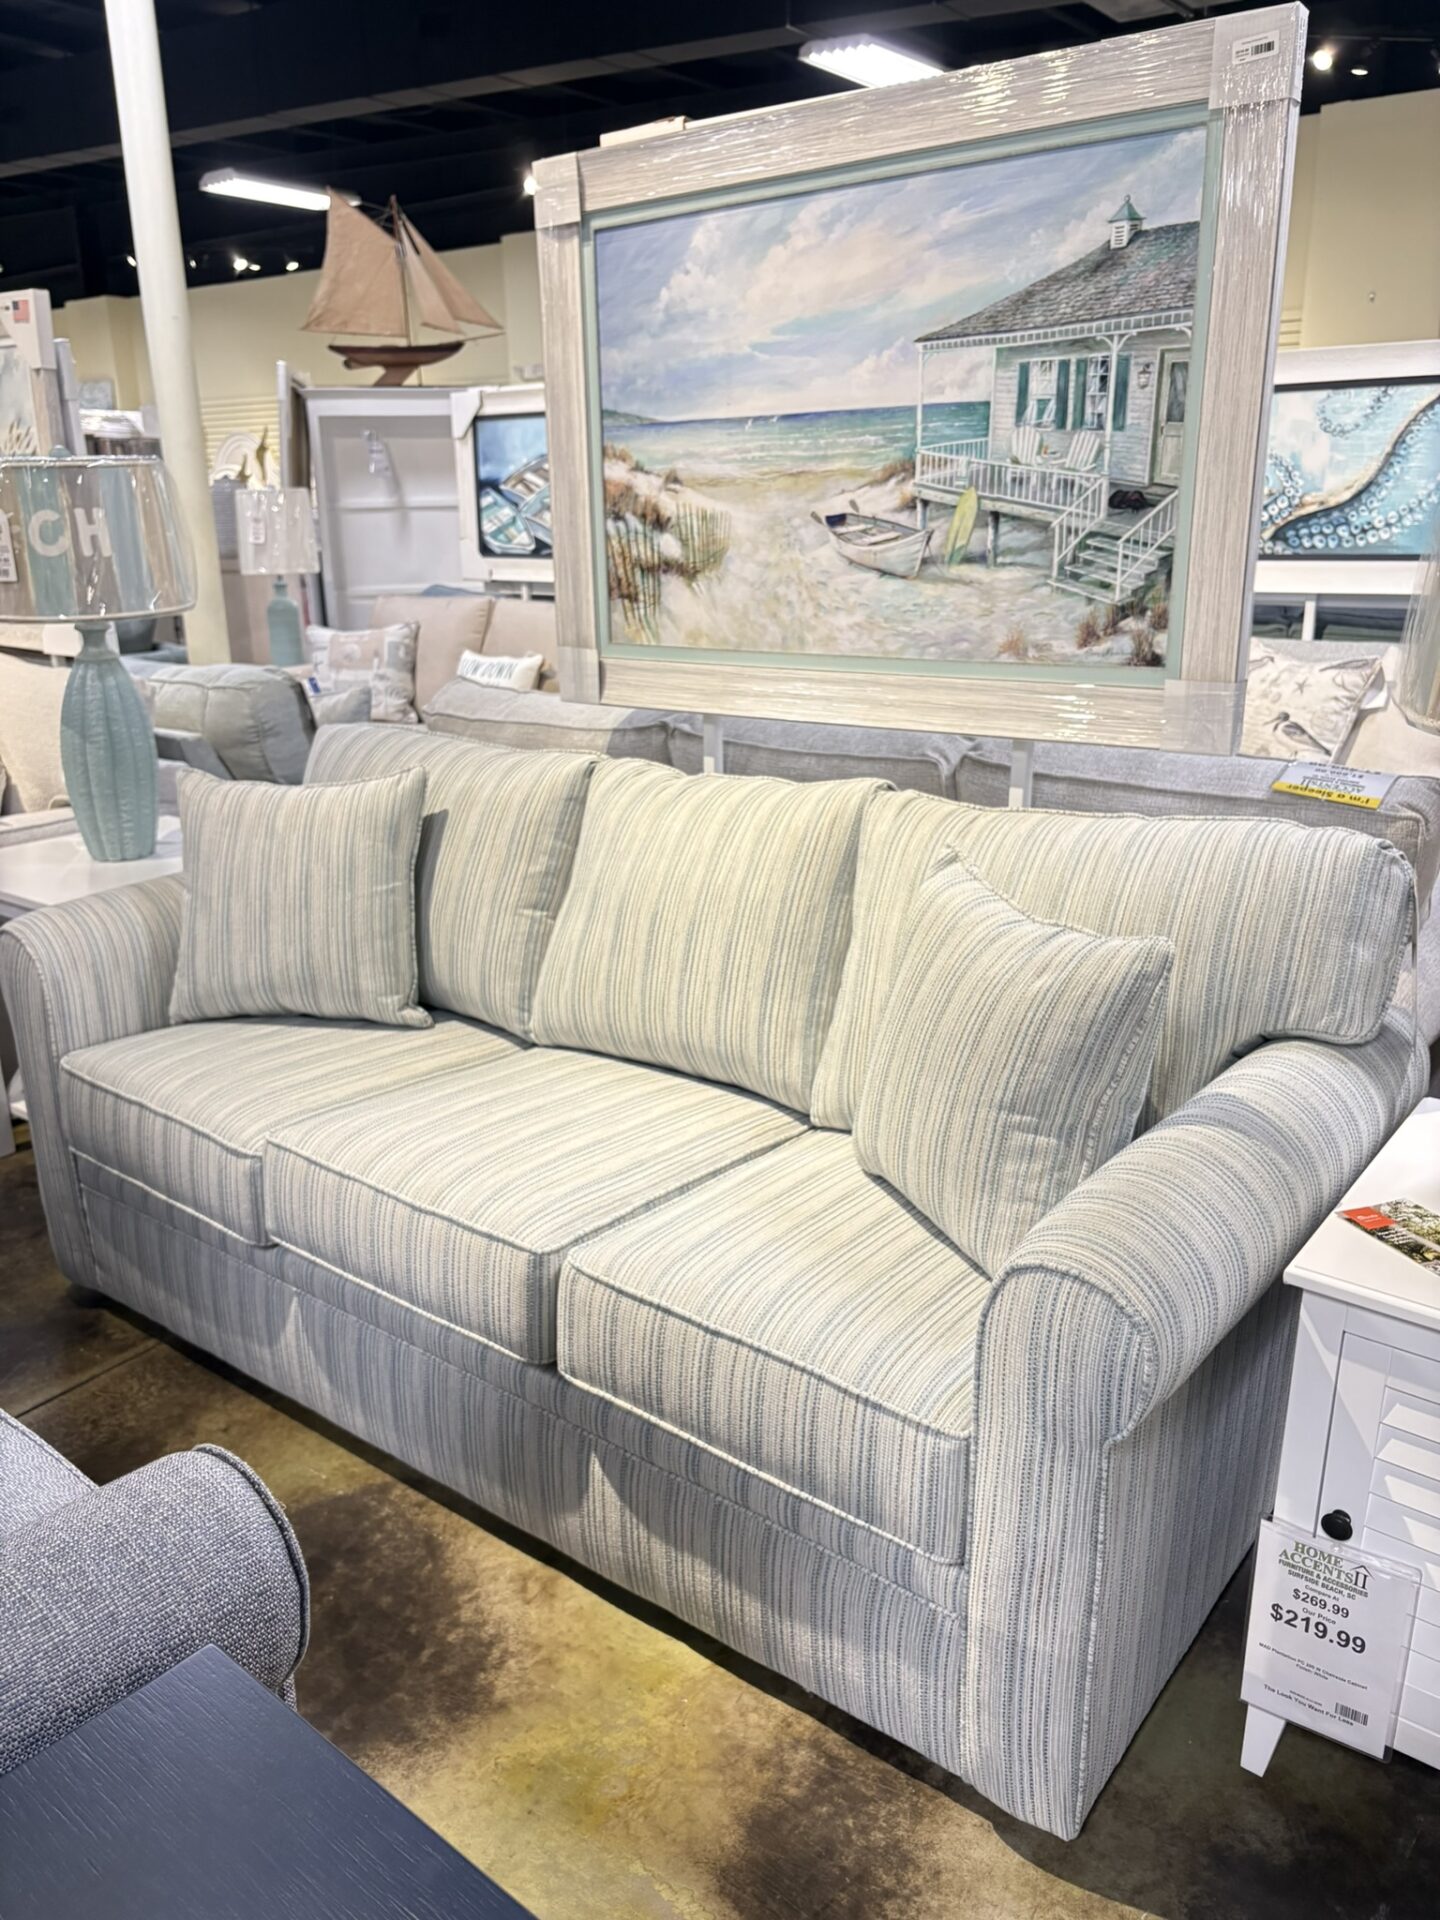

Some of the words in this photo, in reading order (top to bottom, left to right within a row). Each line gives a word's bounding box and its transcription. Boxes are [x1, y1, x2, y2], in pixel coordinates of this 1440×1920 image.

[1286, 784, 1333, 798] Sleeper
[1349, 795, 1370, 804] I'm
[1279, 1549, 1354, 1584] ACCENTS
[1294, 1541, 1344, 1568] HOME
[1278, 1559, 1314, 1577] FURNITURE
[1322, 1576, 1369, 1598] ACCESSORIES
[1288, 1569, 1319, 1586] SURFSIDE
[1321, 1582, 1345, 1597] BEACH,
[1346, 1592, 1357, 1600] SC
[1305, 1584, 1332, 1599] Compare
[1292, 1588, 1349, 1618] $269.99
[1302, 1607, 1316, 1617] Our
[1317, 1612, 1336, 1625] Price
[1270, 1602, 1366, 1654] $219.99
[1264, 1684, 1276, 1693] The
[1276, 1689, 1293, 1700] Look
[1294, 1697, 1307, 1707] You
[1307, 1704, 1325, 1715] Want
[1325, 1710, 1337, 1719] For
[1338, 1716, 1354, 1726] Less
